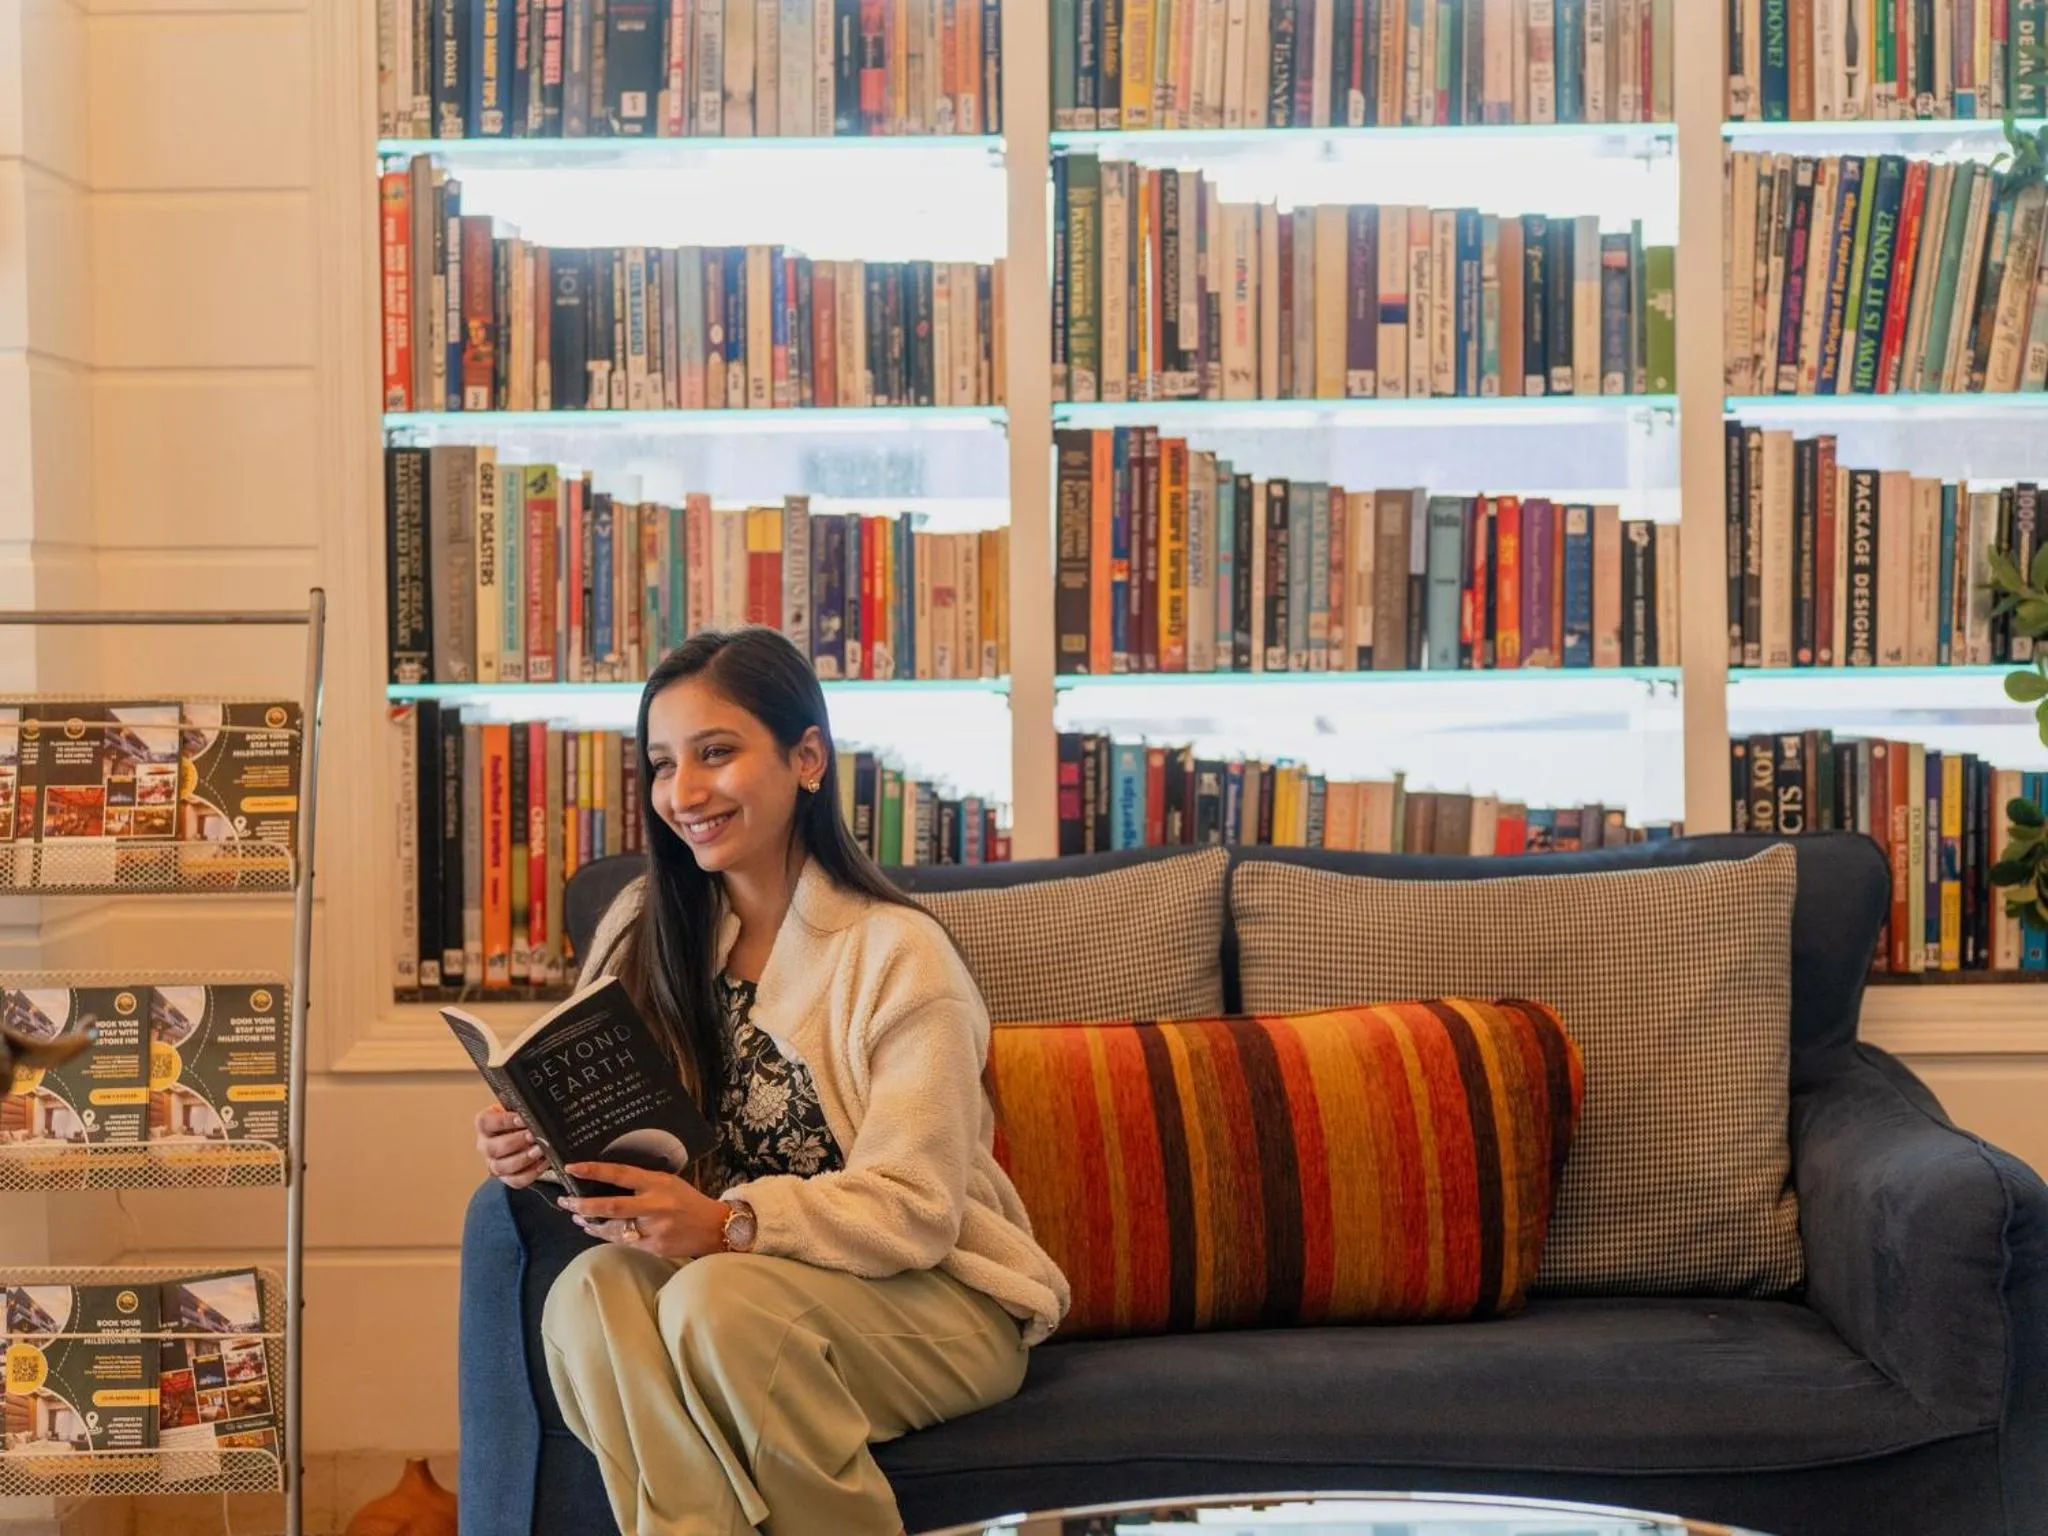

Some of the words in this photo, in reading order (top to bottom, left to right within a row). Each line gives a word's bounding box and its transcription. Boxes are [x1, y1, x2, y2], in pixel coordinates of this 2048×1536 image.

[444, 39, 457, 88] HOME
[1869, 210, 1895, 281] DONE?
[1413, 250, 1428, 290] Digital
[1415, 293, 1428, 338] Camera
[1866, 287, 1884, 306] IT
[1864, 312, 1880, 330] IS
[1856, 337, 1875, 388] HOW
[480, 462, 494, 507] GREAT
[1170, 491, 1184, 542] nature
[1855, 473, 1871, 566] PACKAGE
[2018, 489, 2036, 532] 1000
[480, 512, 494, 587] DISASTERS
[1188, 489, 1202, 588] PHOTOGRAPHY
[1170, 548, 1184, 590] turns
[1167, 595, 1184, 637] nasty
[444, 735, 456, 777] sports
[1753, 745, 1774, 790] JOY
[446, 779, 458, 839] facilities
[1753, 799, 1773, 831] OF
[1894, 804, 1908, 840] Open
[1895, 843, 1907, 903] Kitchens
[217, 1034, 260, 1043] MILESTONE
[261, 1034, 276, 1042] INN
[235, 1026, 254, 1034] STAY
[254, 1025, 276, 1033] WITH
[528, 1024, 632, 1089] BEYOND
[549, 1048, 636, 1103] EARTH
[581, 1089, 601, 1104] PATH
[602, 1083, 614, 1093] TO
[588, 1103, 597, 1112] IN
[599, 1095, 614, 1105] THE
[97, 1319, 119, 1327] BOOK
